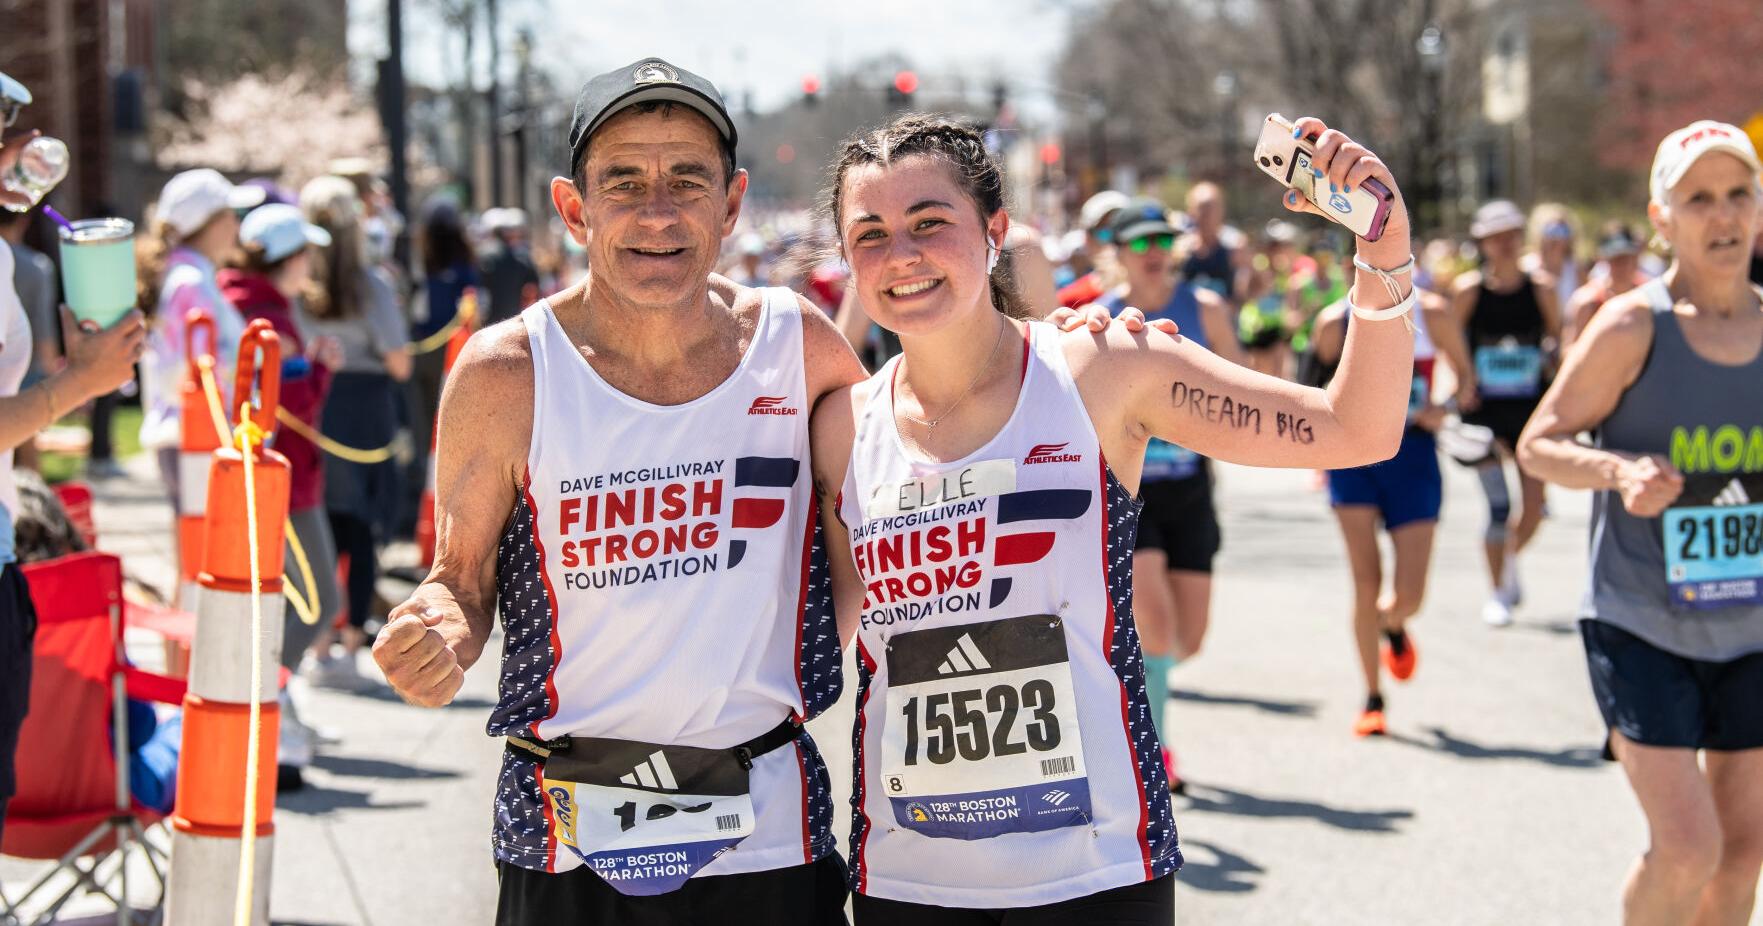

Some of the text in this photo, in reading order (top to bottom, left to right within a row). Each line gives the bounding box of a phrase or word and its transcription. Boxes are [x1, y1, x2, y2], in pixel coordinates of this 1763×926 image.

[1171, 381, 1316, 445] DREAM BIG
[560, 459, 725, 494] DAVE MCGILLIVRAY
[1023, 453, 1082, 465] ATHLETICS EAST
[559, 478, 724, 536] FINISH
[853, 497, 988, 542] DAVE MCGILLIVRAY
[561, 521, 719, 569] STRONG
[854, 516, 986, 582] FINISH
[1677, 513, 1763, 561] 2198
[564, 553, 718, 590] FOUNDATION
[862, 560, 982, 611] TRONG
[902, 678, 1062, 767] 15523
[889, 776, 903, 792] 8
[959, 795, 1017, 811] BOSTON
[626, 850, 688, 867] BOSTON
